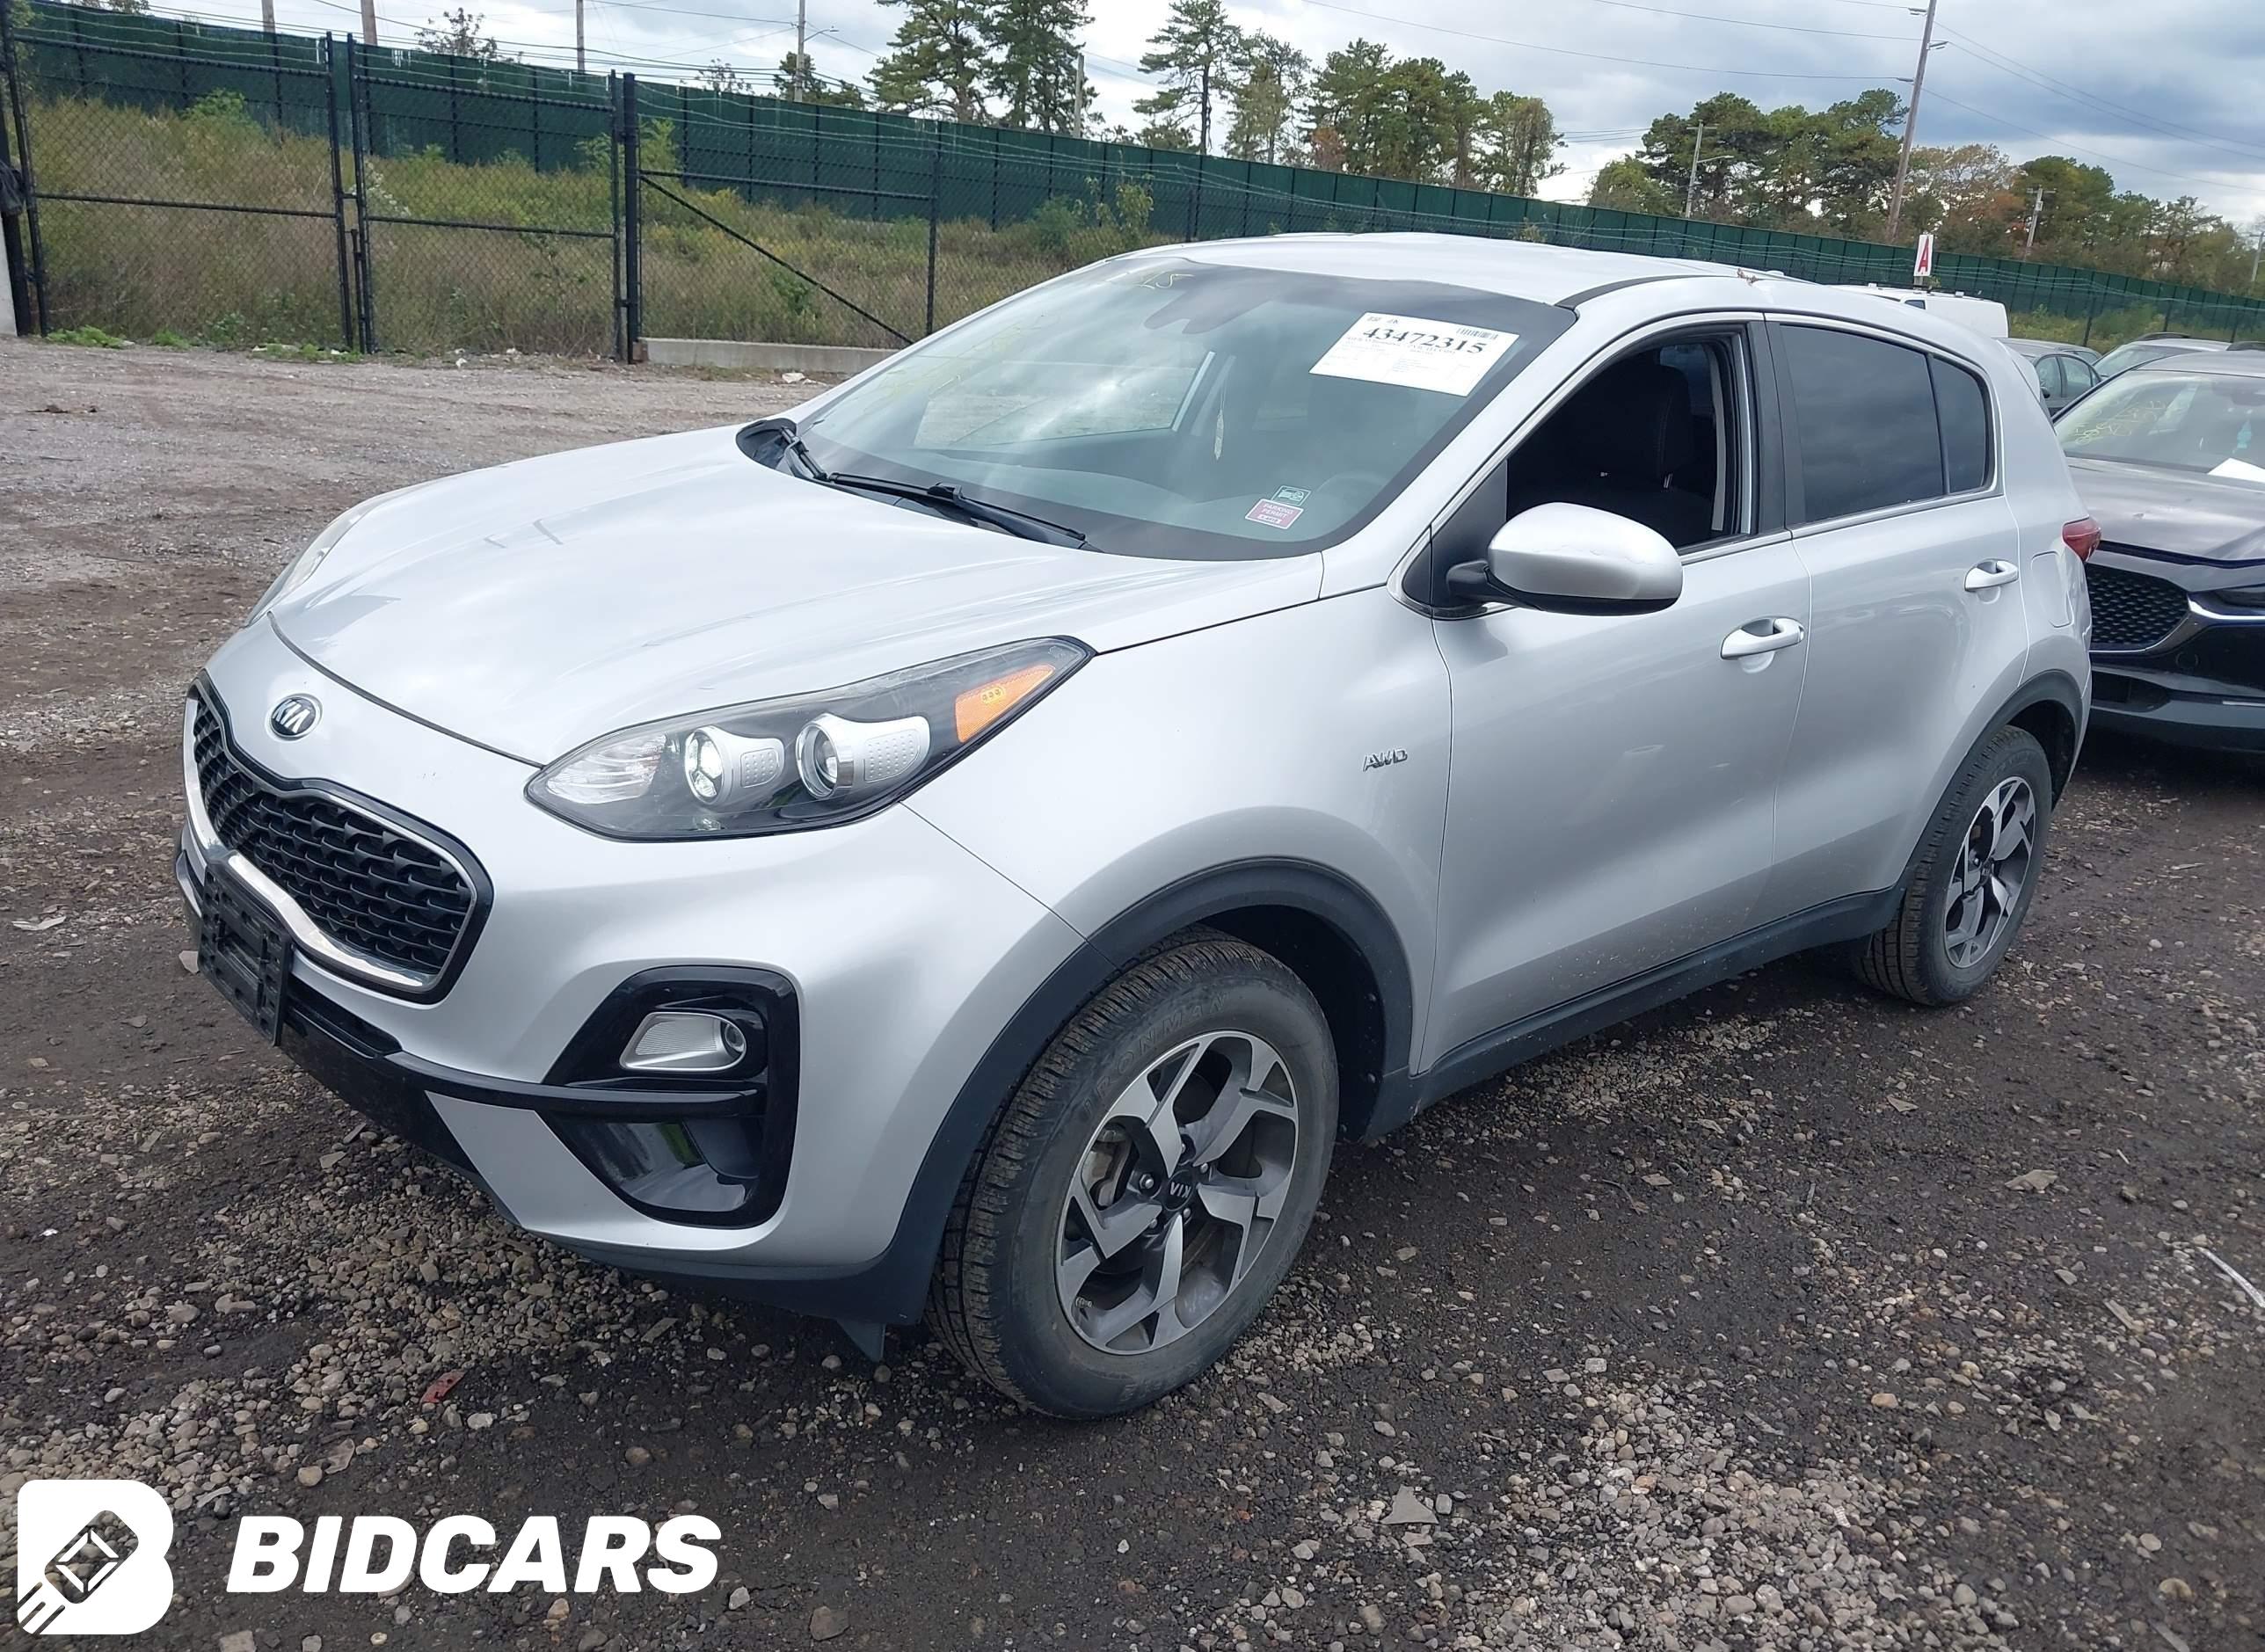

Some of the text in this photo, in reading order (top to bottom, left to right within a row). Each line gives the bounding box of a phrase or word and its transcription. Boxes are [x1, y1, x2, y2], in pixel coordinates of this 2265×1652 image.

[1918, 235, 1930, 273] A
[1362, 326, 1488, 354] 43472315
[1362, 749, 1409, 772] AWD
